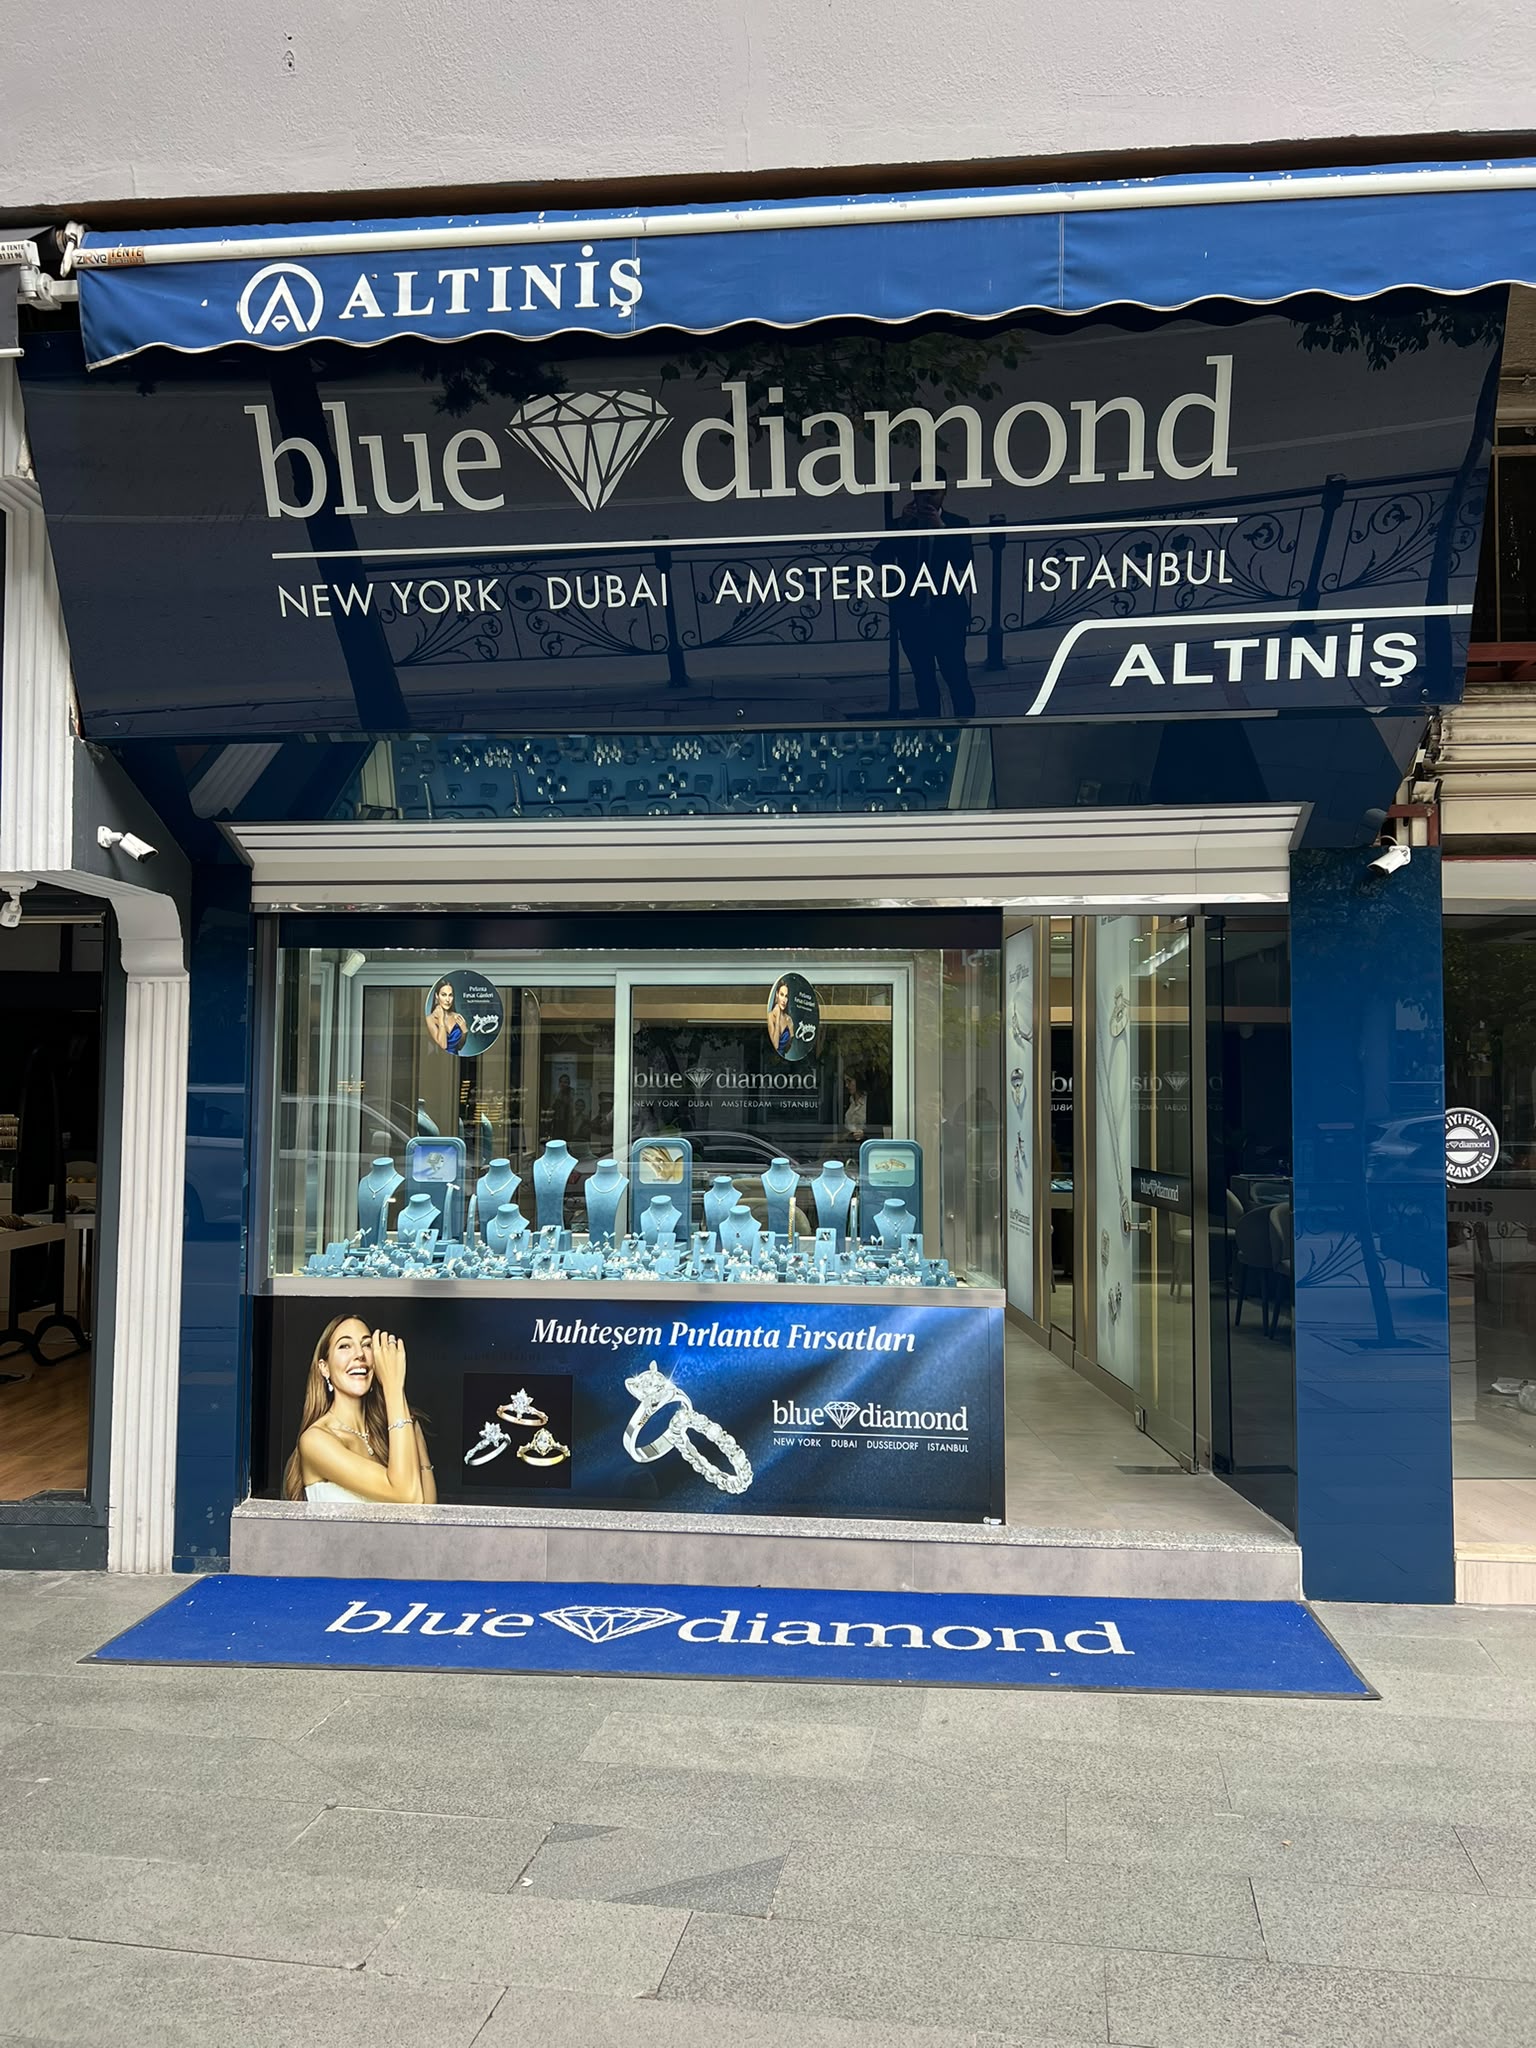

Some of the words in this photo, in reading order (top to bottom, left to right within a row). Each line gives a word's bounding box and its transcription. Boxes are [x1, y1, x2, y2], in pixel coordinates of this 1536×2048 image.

[338, 245, 643, 318] ALTINİŞ
[243, 402, 505, 519] blue
[682, 354, 1238, 502] diamond
[278, 583, 374, 618] NEW
[390, 578, 502, 614] YORK
[546, 573, 668, 610] DUBAI
[715, 559, 978, 605] AMSTERDAM
[1027, 549, 1233, 593] ISTANBUL
[1110, 623, 1418, 688] ALTINİŞ
[634, 1067, 683, 1089] blue
[716, 1067, 818, 1090] diamond
[634, 1100, 653, 1108] NEW
[658, 1100, 680, 1108] YORK
[688, 1100, 713, 1108] DUBAI
[721, 1100, 772, 1109] AMSTERDAM
[780, 1100, 818, 1109] ISTANBUL
[531, 1318, 661, 1351] Muhteşem
[668, 1321, 780, 1348] Pırlanta
[786, 1324, 916, 1352] Fırsatları
[772, 1400, 824, 1426] blue
[859, 1403, 968, 1431] diamond
[773, 1437, 796, 1447] NEW
[798, 1438, 821, 1447] YORK
[831, 1439, 858, 1448] DUBAI
[867, 1440, 919, 1451] DUSSELDORF
[927, 1442, 969, 1453] ISTANBUL
[325, 1600, 535, 1637] blue
[677, 1610, 1136, 1655] diamond
